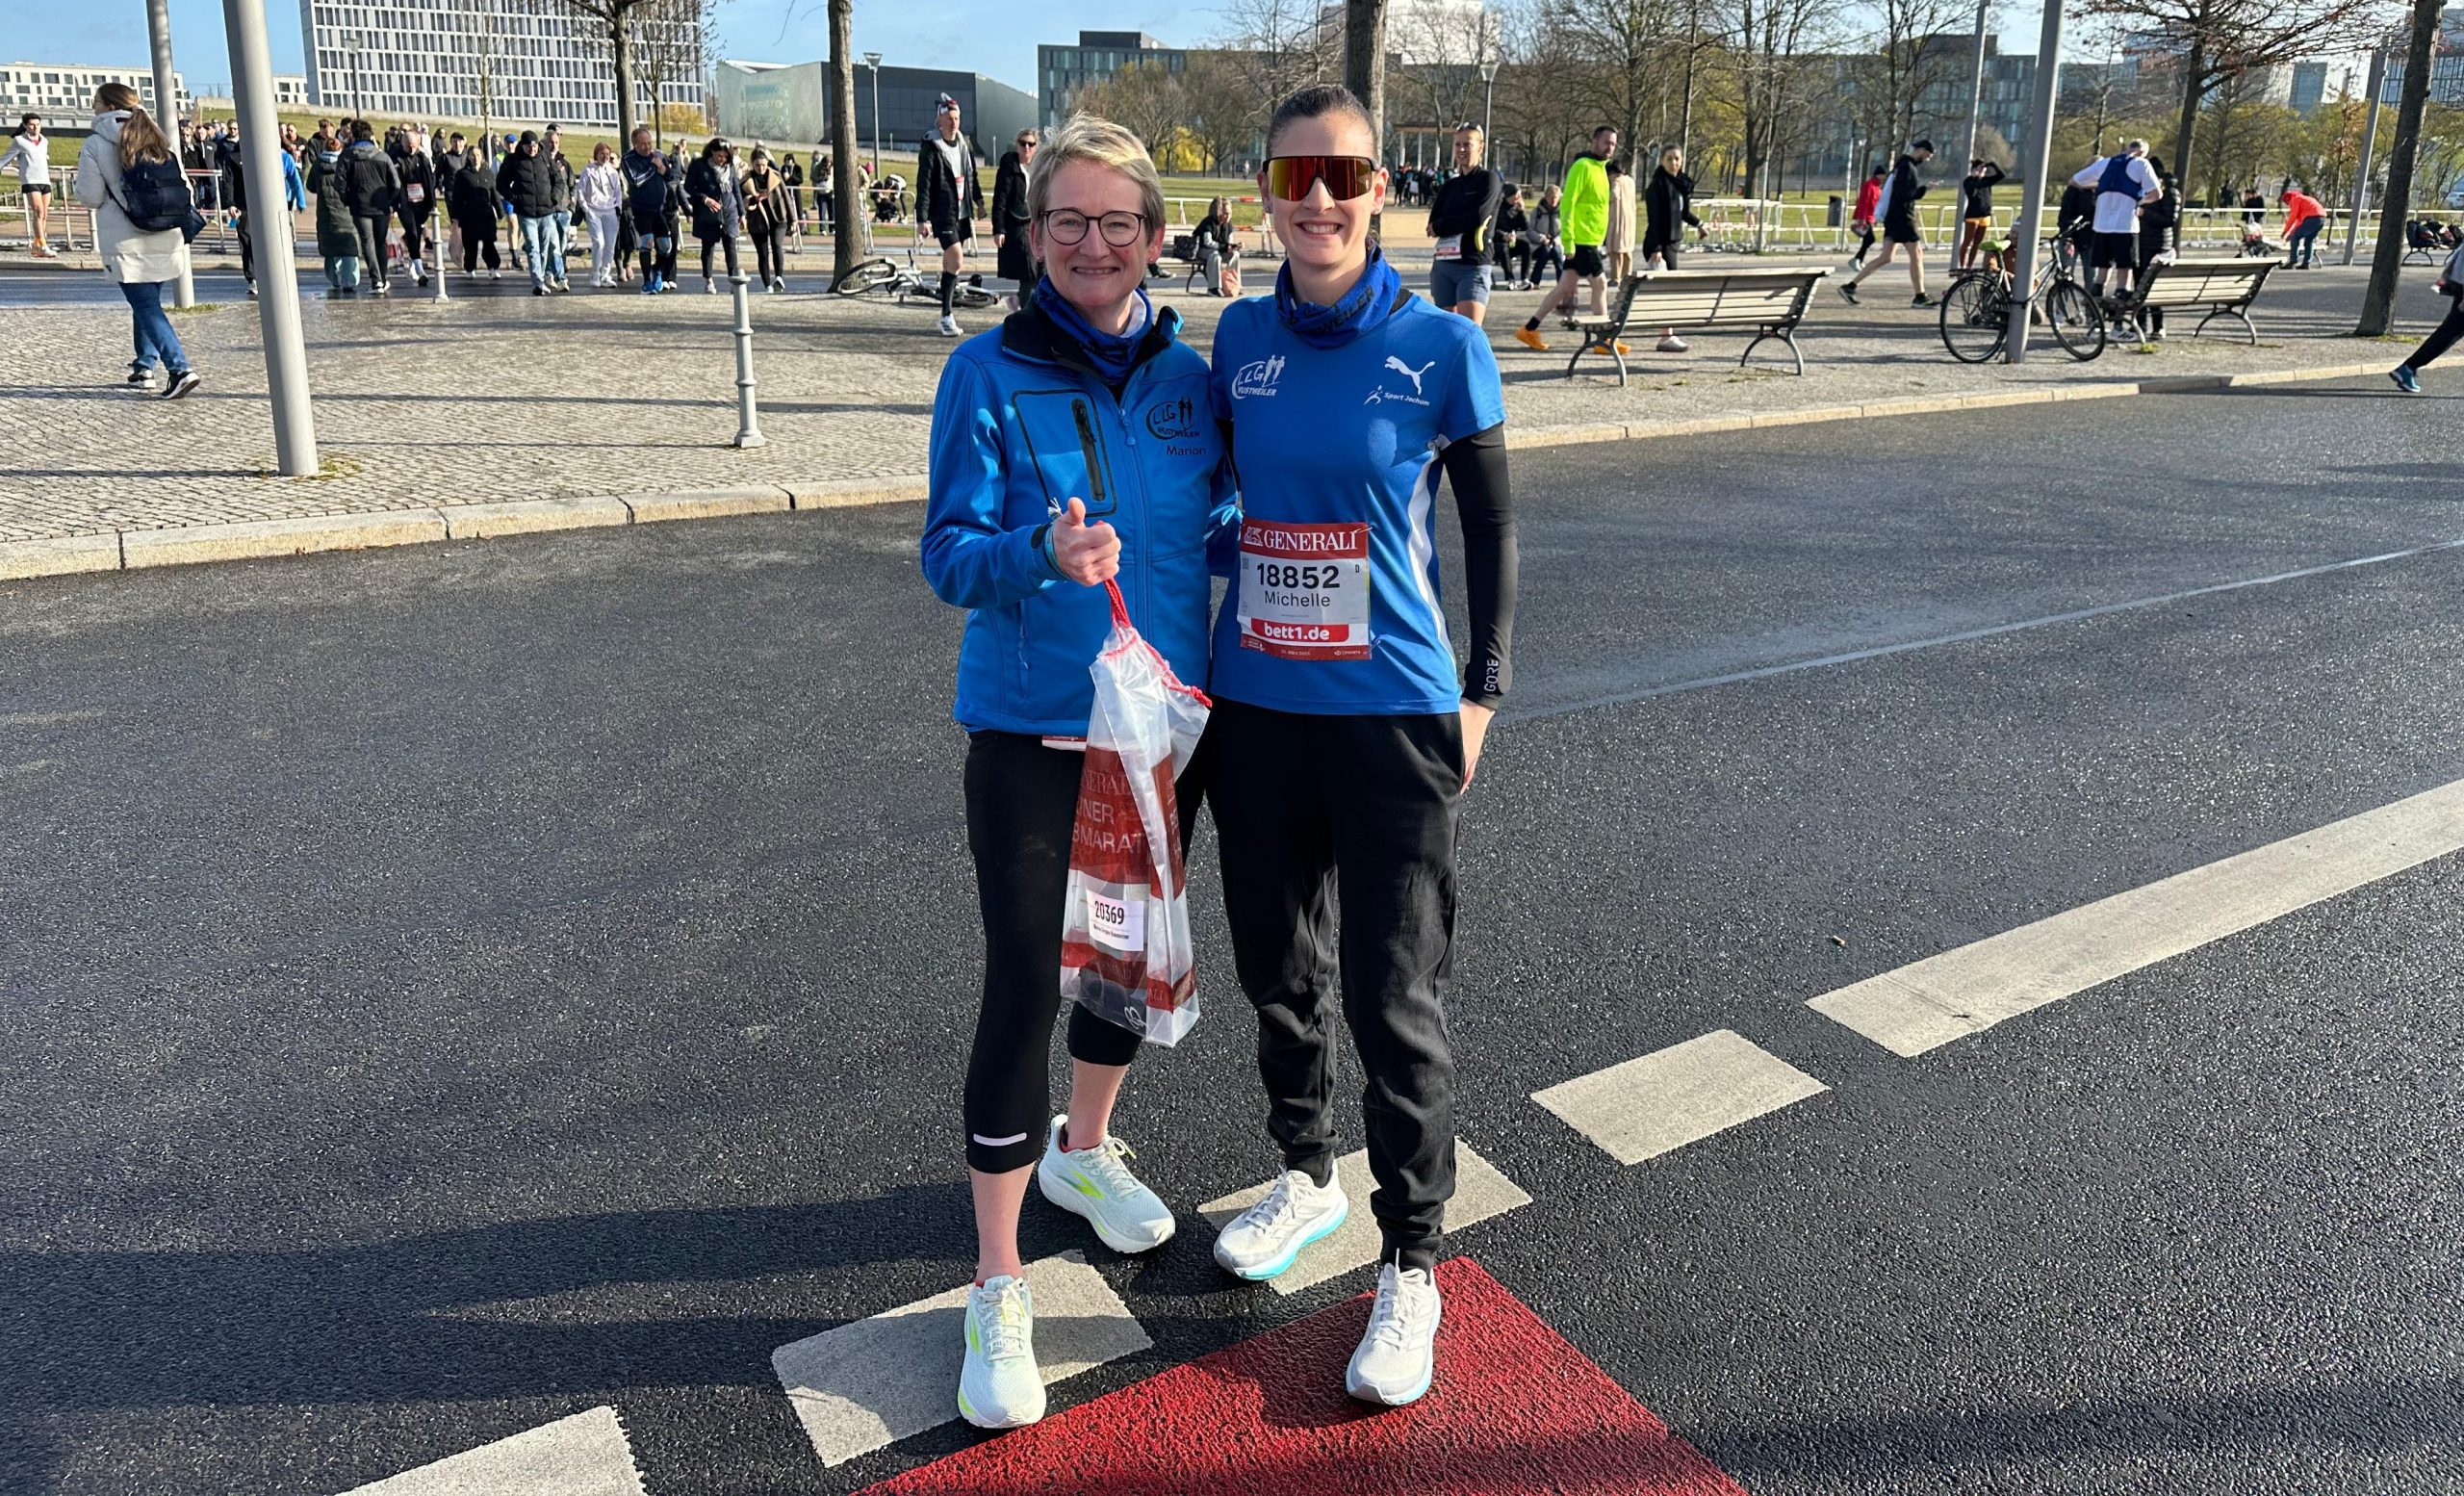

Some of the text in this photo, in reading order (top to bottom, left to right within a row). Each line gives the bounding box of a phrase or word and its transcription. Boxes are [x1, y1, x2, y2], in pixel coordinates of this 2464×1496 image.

[1237, 364, 1265, 386] LLG
[1383, 392, 1430, 406] Sport Jochum
[1153, 403, 1176, 425] LLG
[1167, 445, 1207, 456] Marion
[1264, 529, 1357, 552] GENERALI
[1257, 562, 1341, 589] 18852
[1265, 590, 1331, 607] Michelle
[1264, 622, 1330, 640] bett1.de
[1483, 659, 1500, 692] GORE
[1094, 900, 1125, 925] 20369
